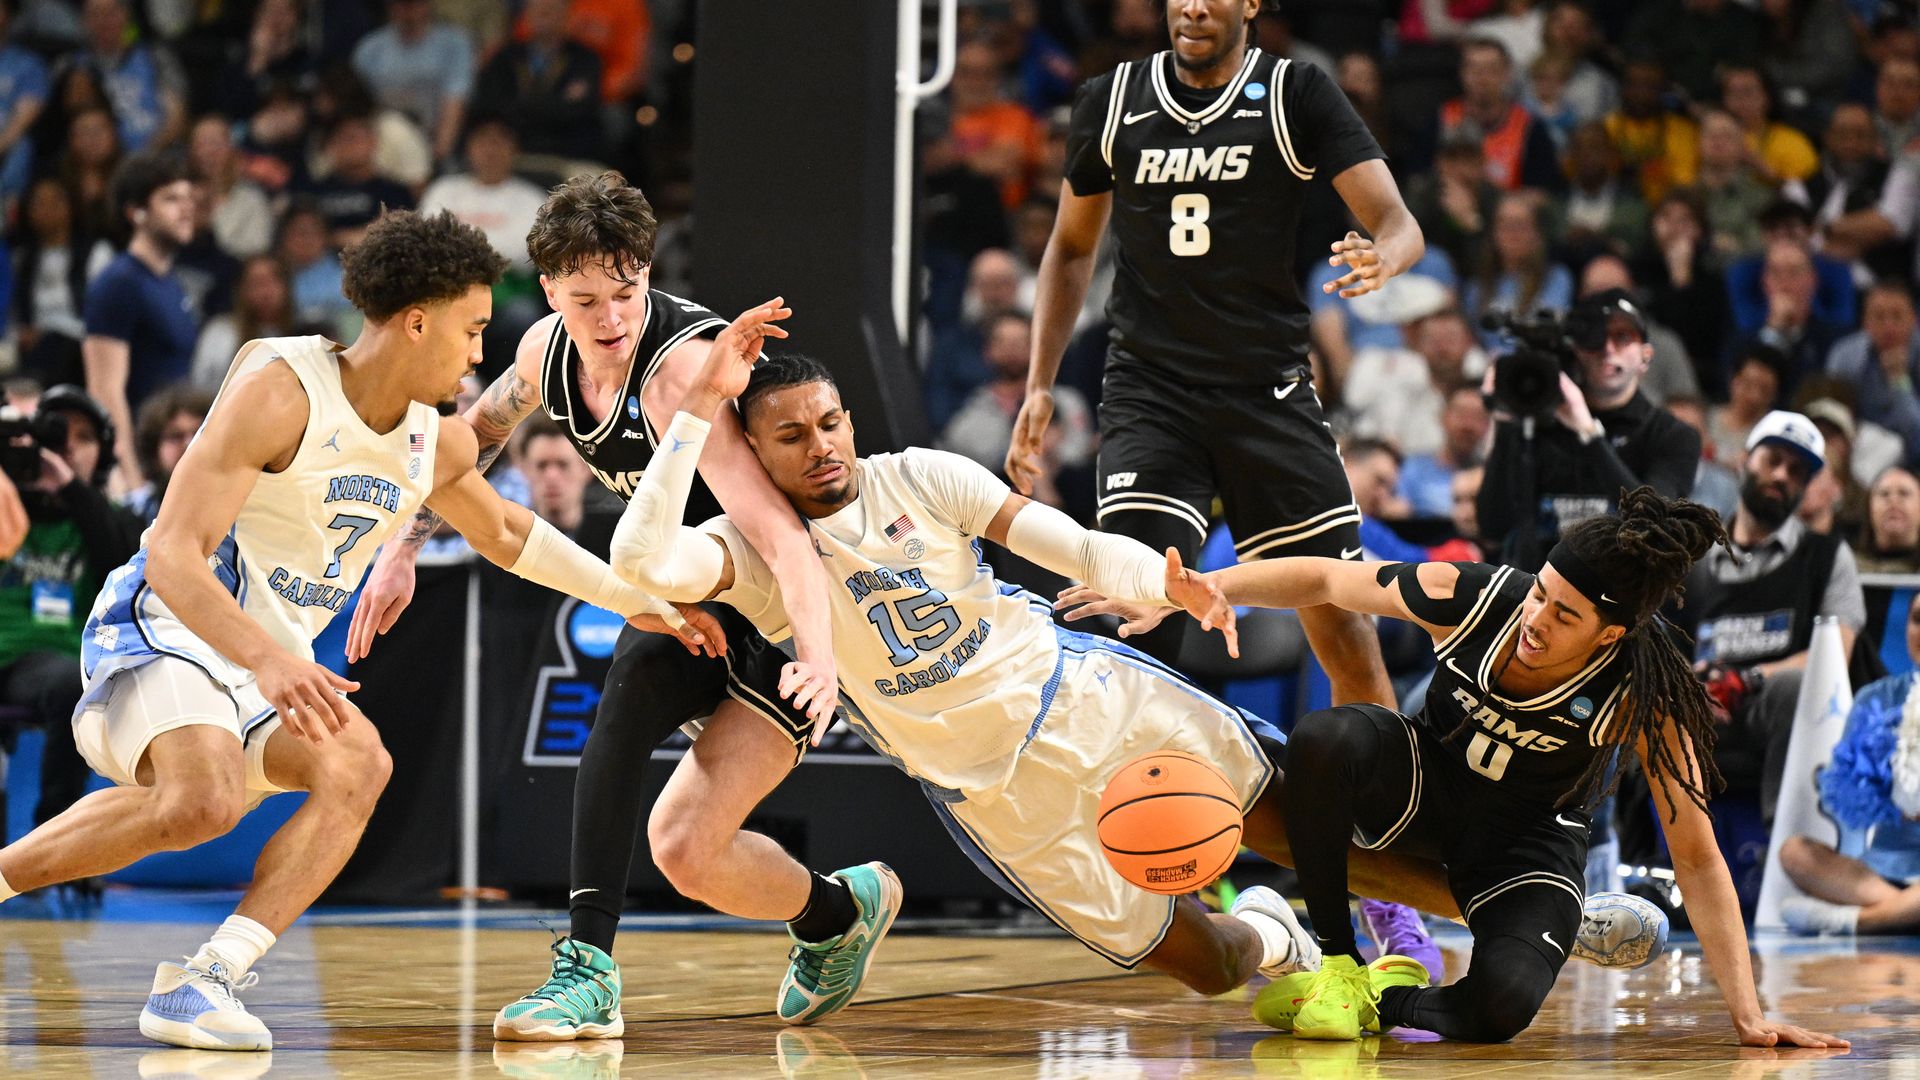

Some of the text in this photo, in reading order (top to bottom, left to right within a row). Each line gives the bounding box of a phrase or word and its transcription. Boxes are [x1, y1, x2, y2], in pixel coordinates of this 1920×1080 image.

[1135, 145, 1253, 184] RAMS
[1169, 193, 1210, 256] 8
[324, 475, 401, 514] NORTH
[1106, 472, 1137, 490] VCU
[323, 513, 379, 578] 7
[845, 567, 931, 604] NORH
[867, 589, 962, 667] 15
[875, 618, 991, 697] CAROLINA
[1452, 686, 1567, 753] RAMS
[1466, 730, 1514, 782] 0
[1146, 868, 1183, 878] MADNESS
[1160, 871, 1188, 882] MARCH
